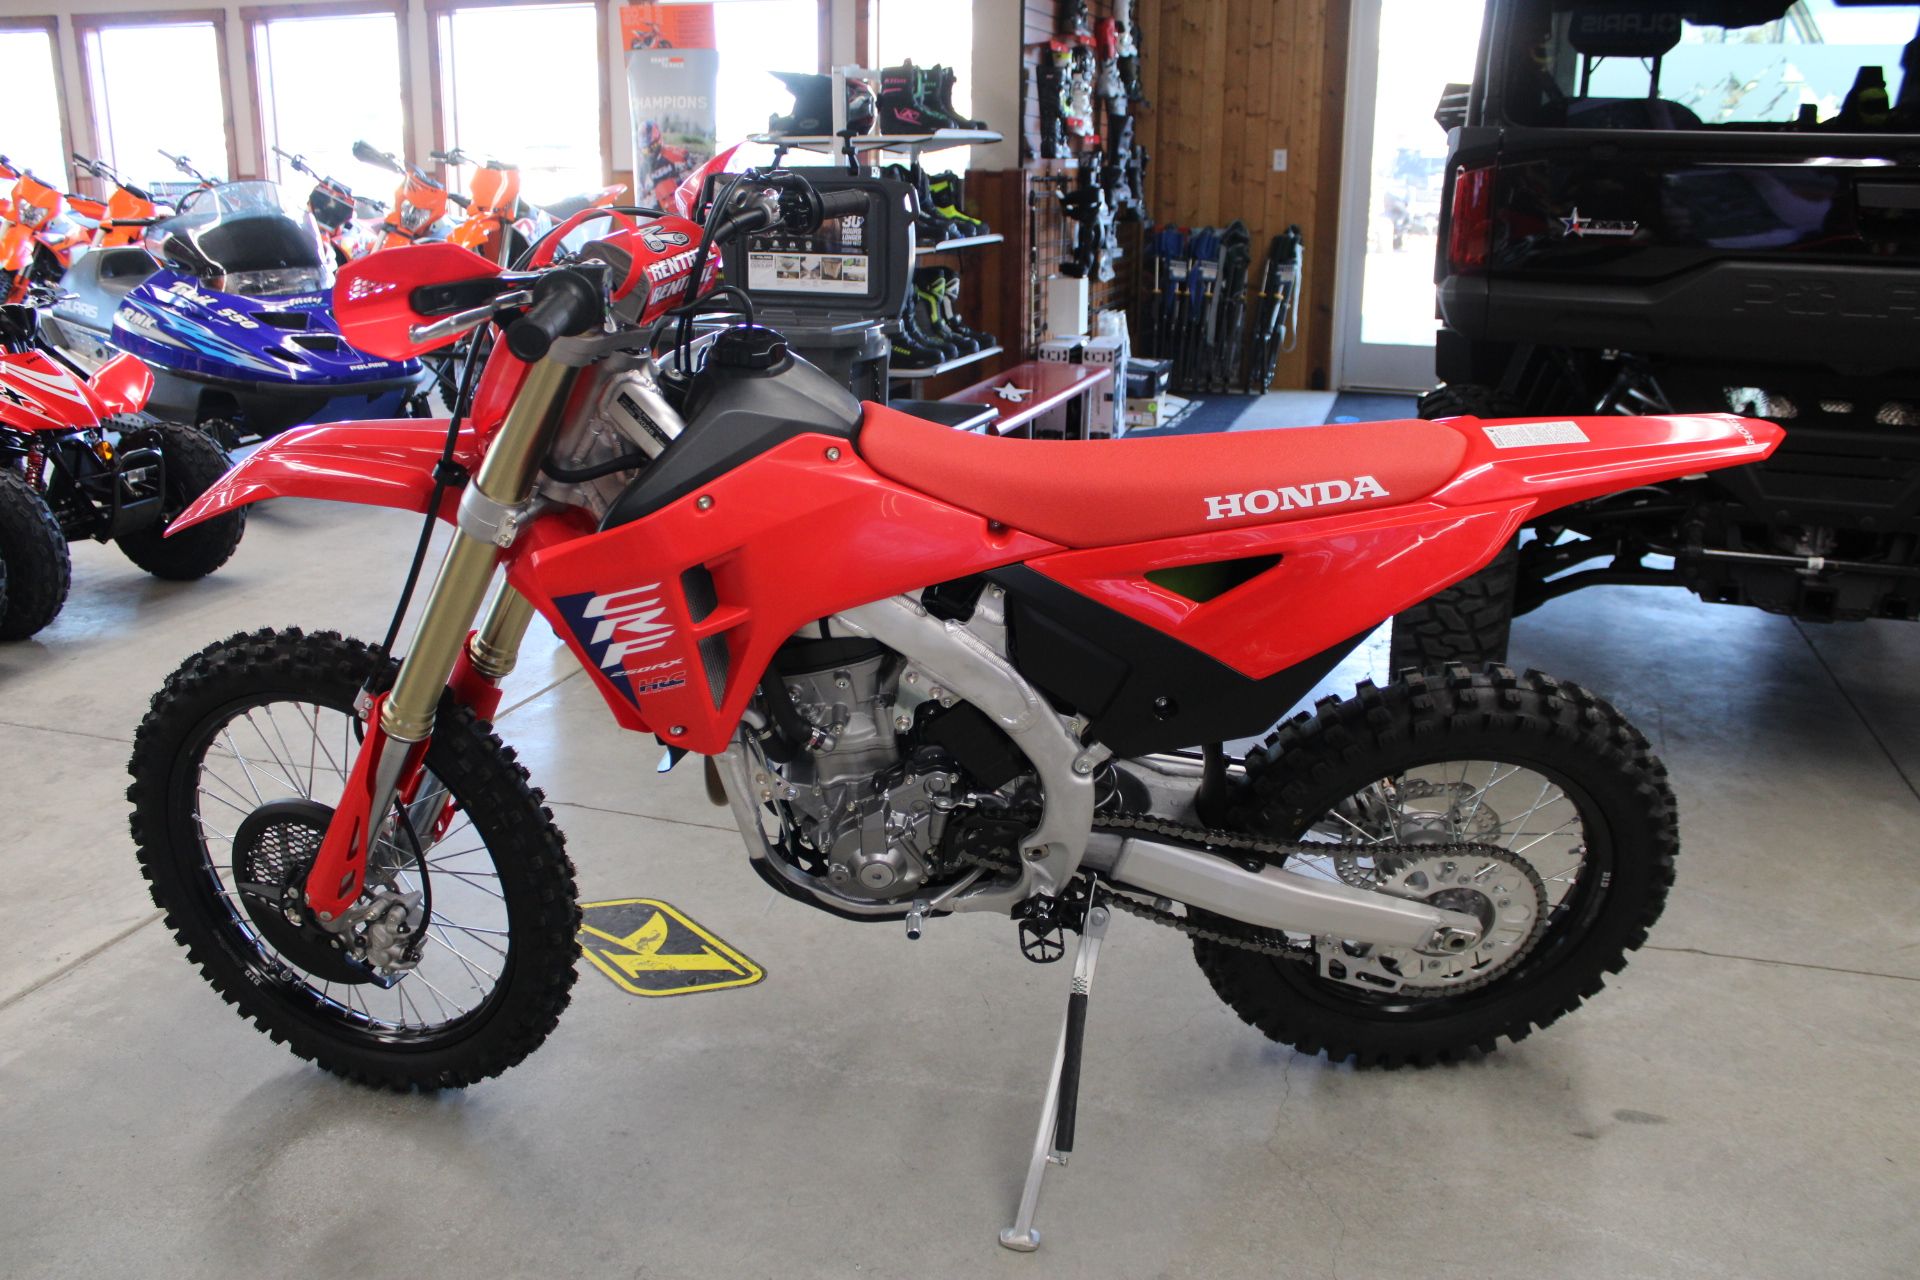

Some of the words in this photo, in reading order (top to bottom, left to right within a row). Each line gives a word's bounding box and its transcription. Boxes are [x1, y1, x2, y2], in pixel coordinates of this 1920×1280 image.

[121, 307, 157, 331] RMK
[217, 308, 259, 329] 550
[349, 361, 388, 371] POLARIS
[1204, 475, 1390, 521] HONDA
[582, 582, 676, 669] CRF
[609, 657, 685, 678] 250RX
[639, 670, 687, 695] HRC
